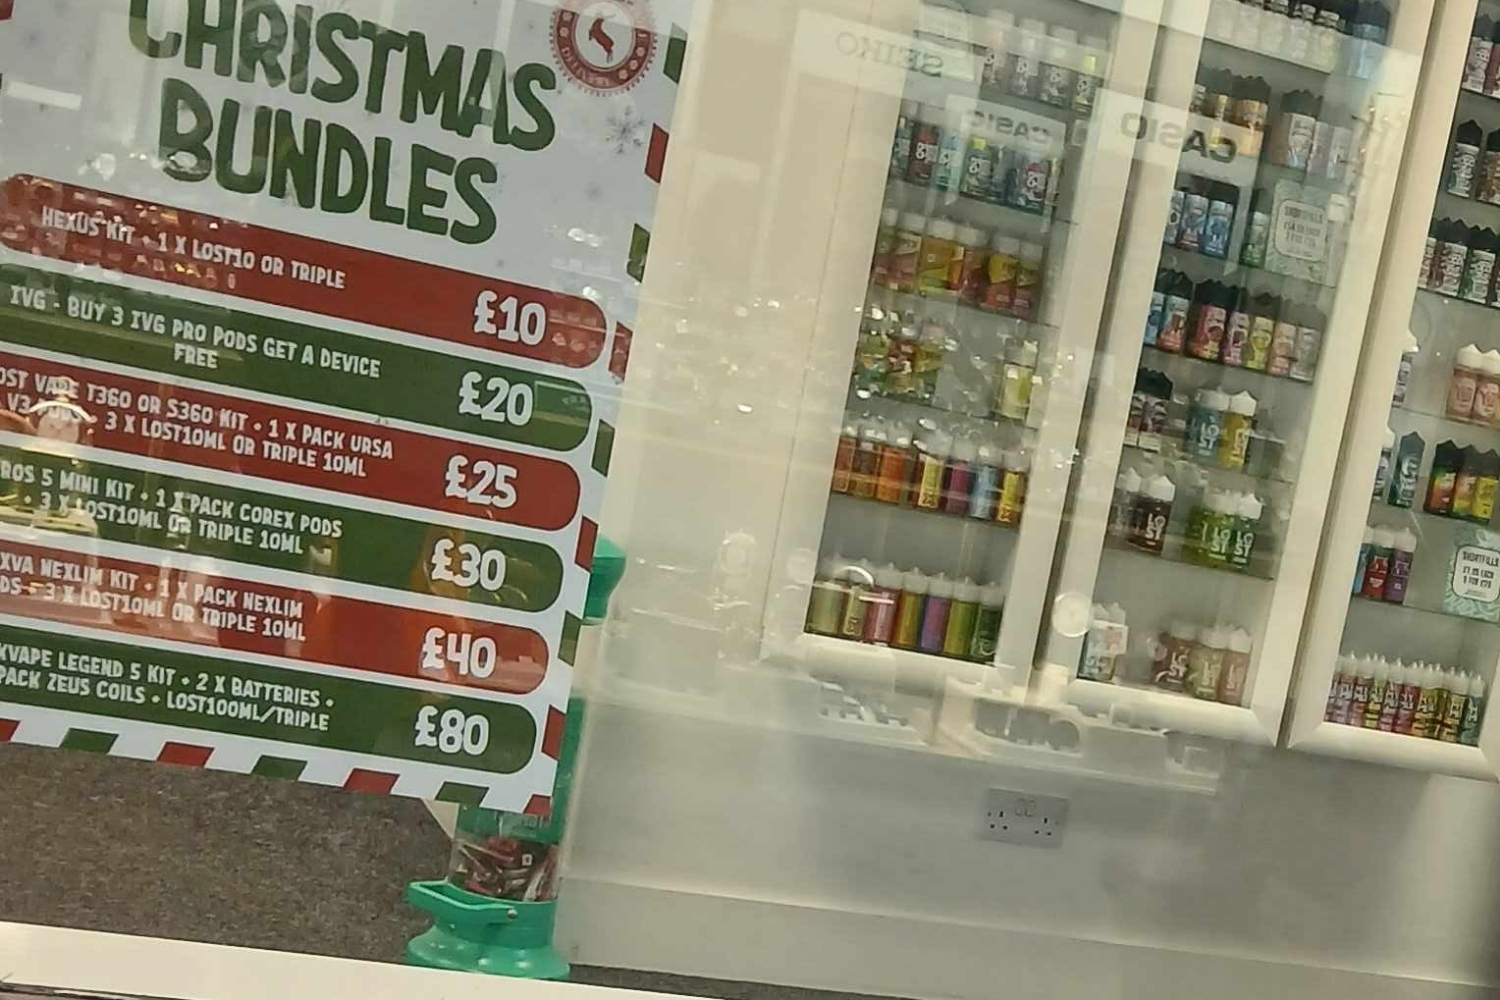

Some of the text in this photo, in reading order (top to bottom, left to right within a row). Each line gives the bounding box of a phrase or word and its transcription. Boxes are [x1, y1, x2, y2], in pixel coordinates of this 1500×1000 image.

[128, 0, 557, 152] CHRISTMAS
[157, 77, 499, 246] BUNDLES
[41, 205, 101, 236] HEXUS
[106, 219, 135, 244] KIT
[175, 232, 187, 255] X
[192, 241, 255, 270] LOST10
[261, 255, 284, 275] OR
[291, 260, 346, 290] TRIPLE
[10, 285, 381, 379] IVG BUY 3 IVG PRO PODS GET A DEVICE
[473, 289, 547, 347] £10
[174, 343, 219, 370] FREE
[86, 382, 132, 409] T360
[137, 395, 161, 416] OR
[166, 398, 213, 425] S360
[219, 407, 249, 431] KIT
[268, 418, 279, 439] 1
[285, 420, 297, 441] X
[302, 424, 347, 450] PACK
[350, 434, 394, 461] URSA
[458, 370, 533, 427] £20
[104, 411, 117, 431] 3
[123, 414, 136, 434] X
[141, 419, 227, 452] LOST10ML
[233, 436, 255, 456] OR
[262, 440, 316, 468] TRIPLE
[323, 452, 367, 479] 10ML
[41, 467, 53, 488] 5
[105, 471, 135, 501] KIT
[155, 489, 166, 509] 1
[190, 493, 234, 520] PACK
[240, 503, 294, 530] COREX
[300, 514, 343, 538] PODS
[445, 453, 518, 509] £25
[40, 490, 303, 555] 3 TRIPLE 10ML
[41, 558, 103, 586] NEXLIM
[110, 568, 139, 592] KIT
[178, 581, 188, 600] X
[194, 583, 237, 608] PACK
[243, 591, 304, 619] NEXLIM
[430, 537, 506, 591] £30
[44, 582, 56, 600] 3
[172, 601, 195, 623] OR
[202, 606, 255, 634] TRIPLE
[262, 616, 306, 642] 10ML
[58, 650, 321, 708] LEGEND 5 KIT 2 X BATTERIES
[421, 625, 497, 679] £40
[46, 672, 90, 696] ZEUS
[96, 679, 145, 705] COILS
[413, 704, 490, 756] £80
